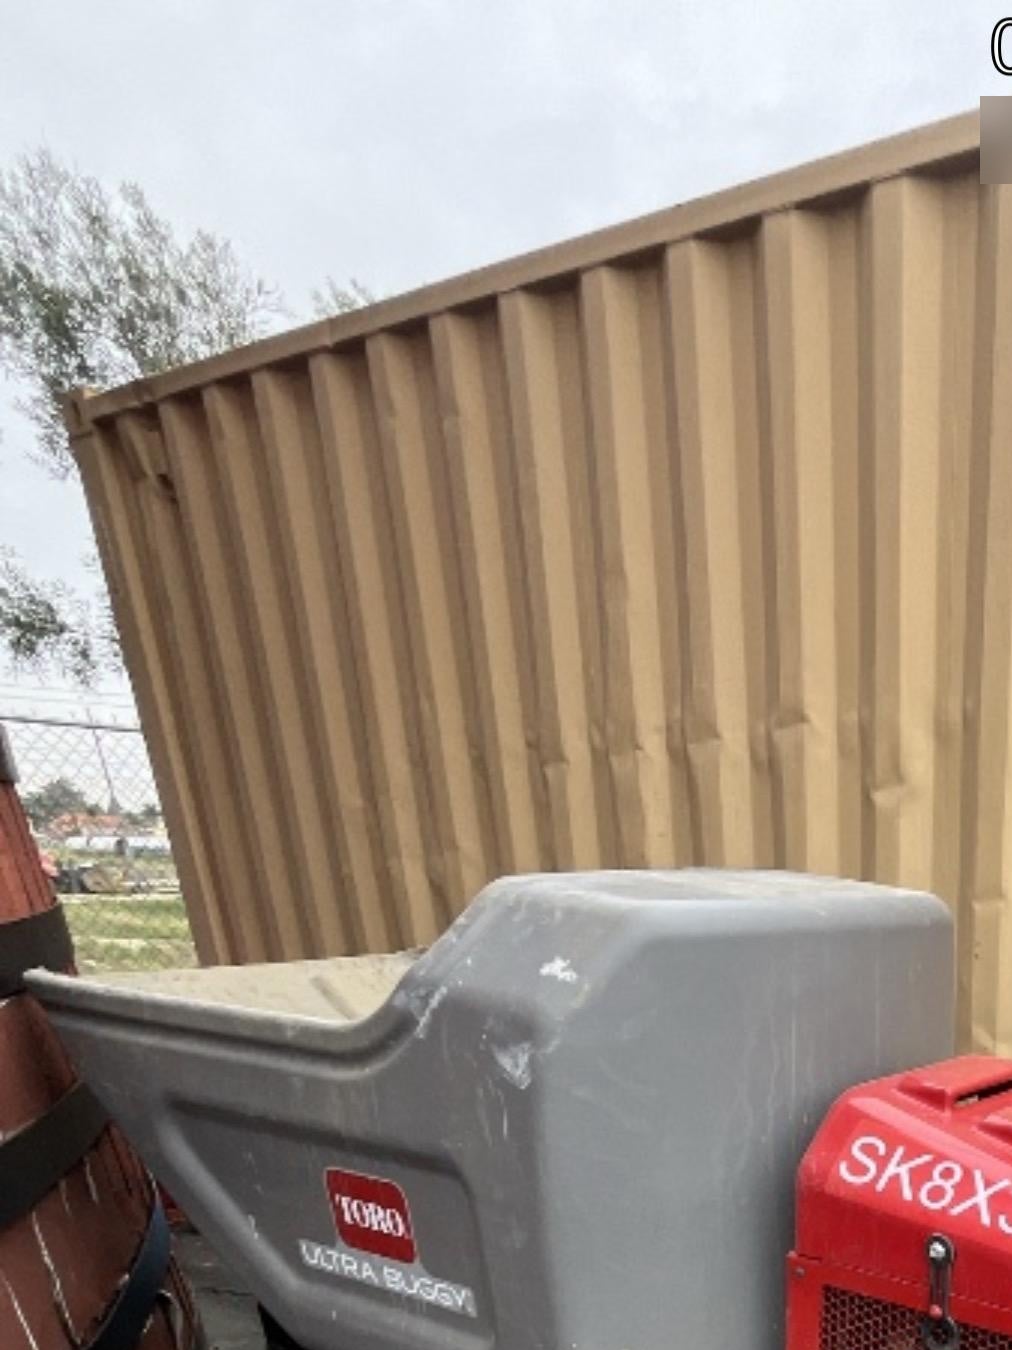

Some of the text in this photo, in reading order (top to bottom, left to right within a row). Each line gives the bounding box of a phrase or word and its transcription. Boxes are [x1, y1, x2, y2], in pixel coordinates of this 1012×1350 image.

[335, 1193, 405, 1237] TORO
[301, 1243, 469, 1308] ULTRA BUGGY
